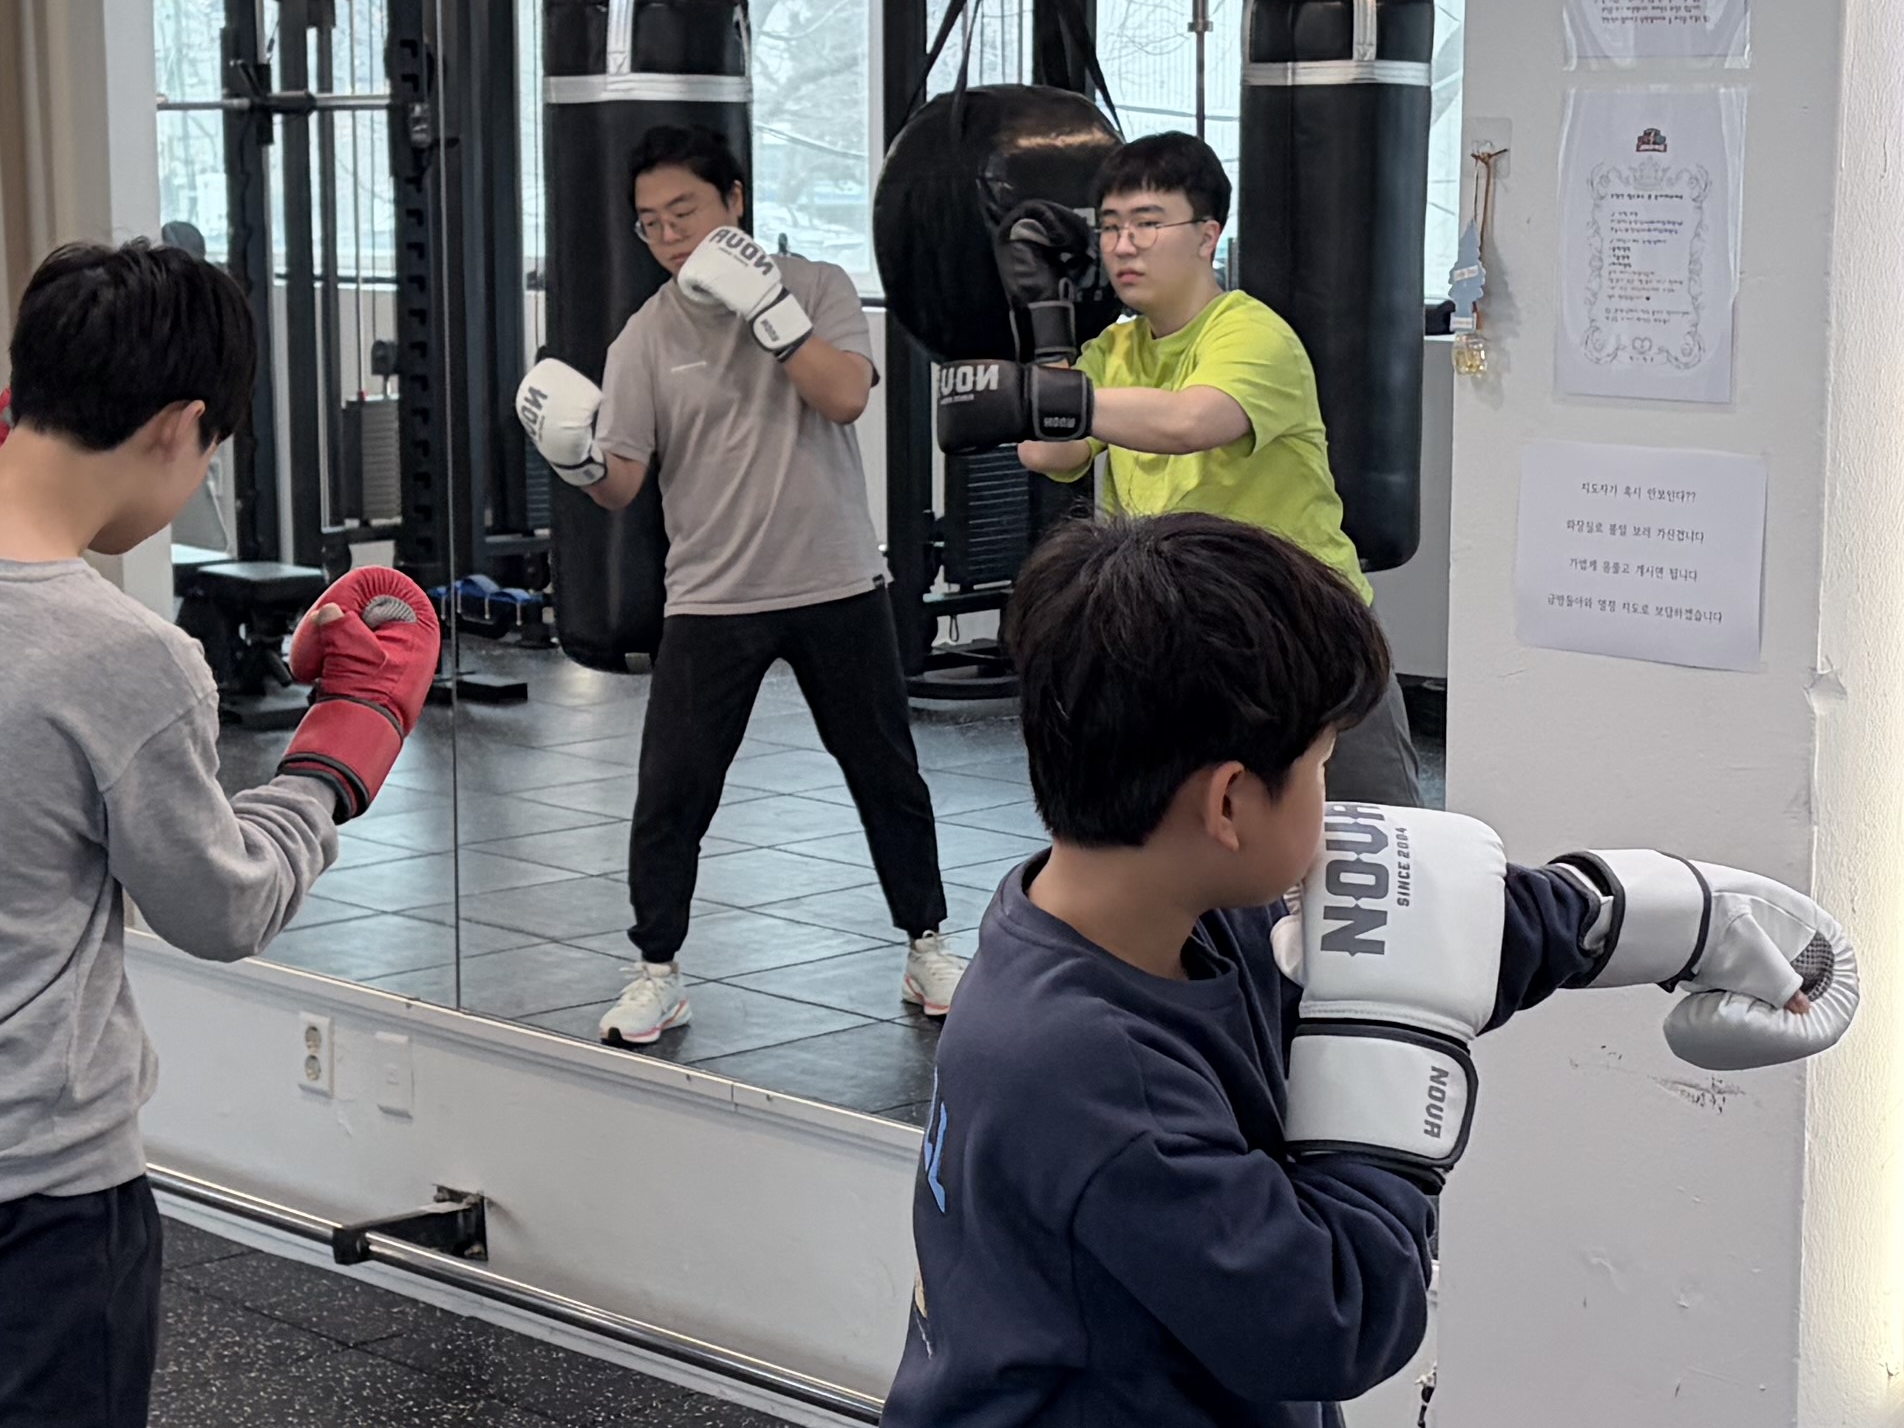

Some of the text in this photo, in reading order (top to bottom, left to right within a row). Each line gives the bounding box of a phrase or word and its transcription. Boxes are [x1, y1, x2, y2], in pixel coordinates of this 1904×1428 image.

[1581, 482, 1697, 503] 지도자가 혹시 안보인다??
[1566, 519, 1704, 544] 화장실로 볼일 보러 가신겁니다
[1570, 557, 1698, 582] 가볍게 몸풀고 계시면 됩니다
[1622, 602, 1649, 616] 지도로
[1655, 606, 1723, 623] 보답하겠습니다
[1395, 827, 1411, 907] SINCE 2004
